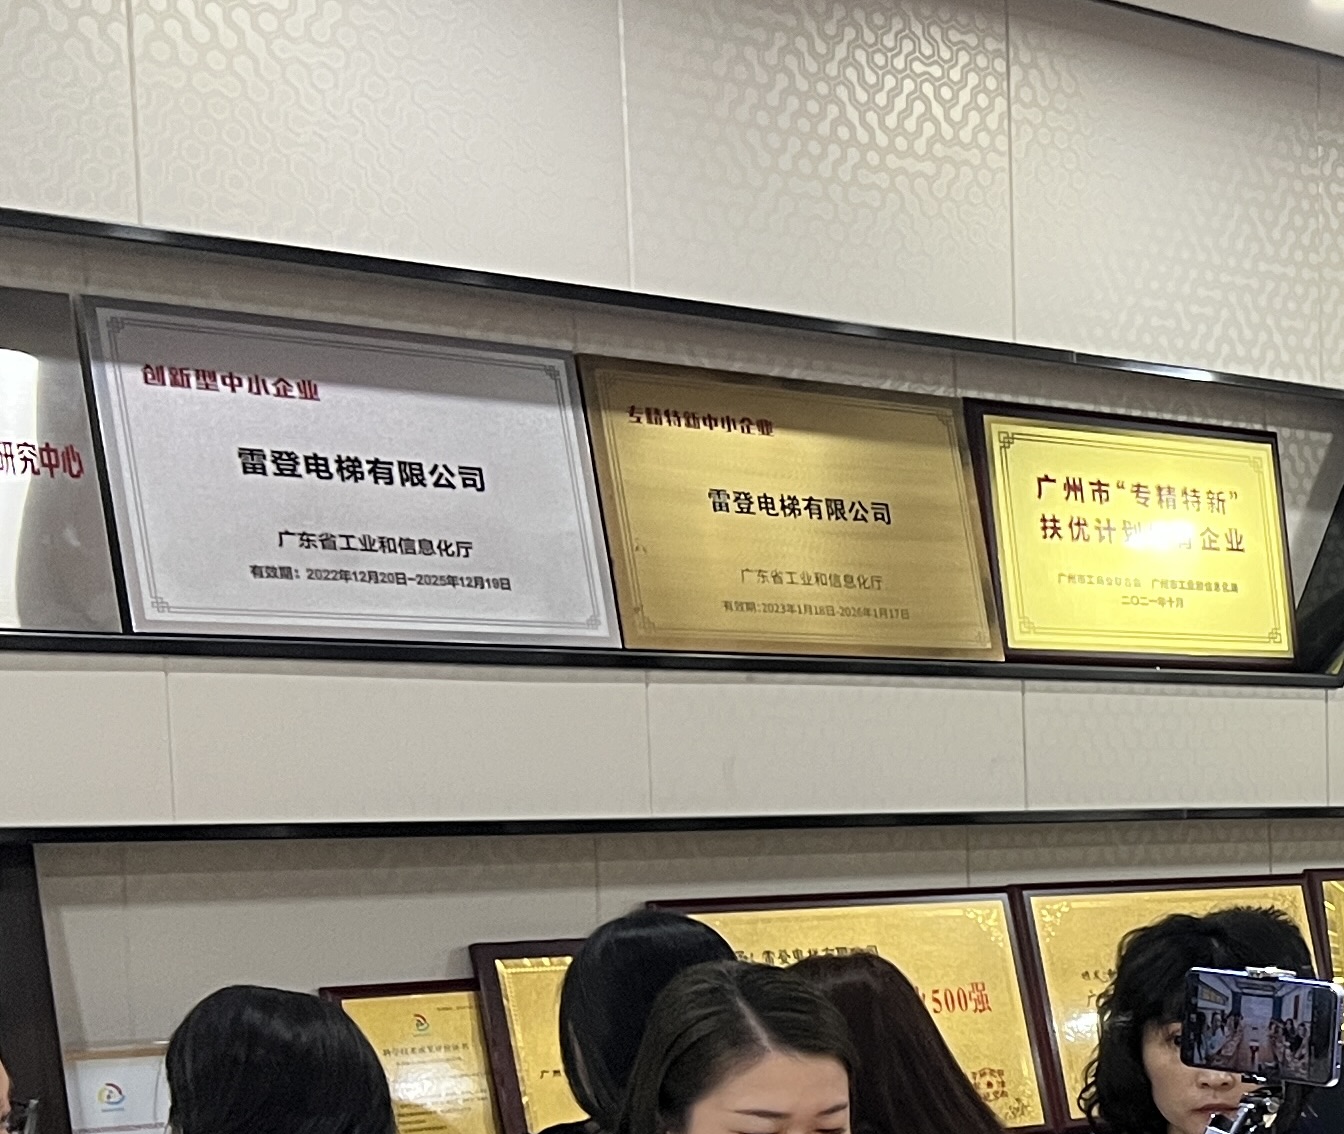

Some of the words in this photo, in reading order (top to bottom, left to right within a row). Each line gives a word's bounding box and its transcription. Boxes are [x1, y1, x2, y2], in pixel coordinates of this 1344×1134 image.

[141, 363, 321, 402] 创新型中小企业
[626, 405, 775, 436] 专精特新中小企业
[237, 446, 486, 493] 雷登电梯有限公司
[708, 488, 892, 526] 雷登电梯有限公司
[278, 529, 473, 560] 广东省工业和信息化厅
[1040, 513, 1246, 554] 扶优计划企业
[740, 568, 884, 591] 广东省工业和信息化厅
